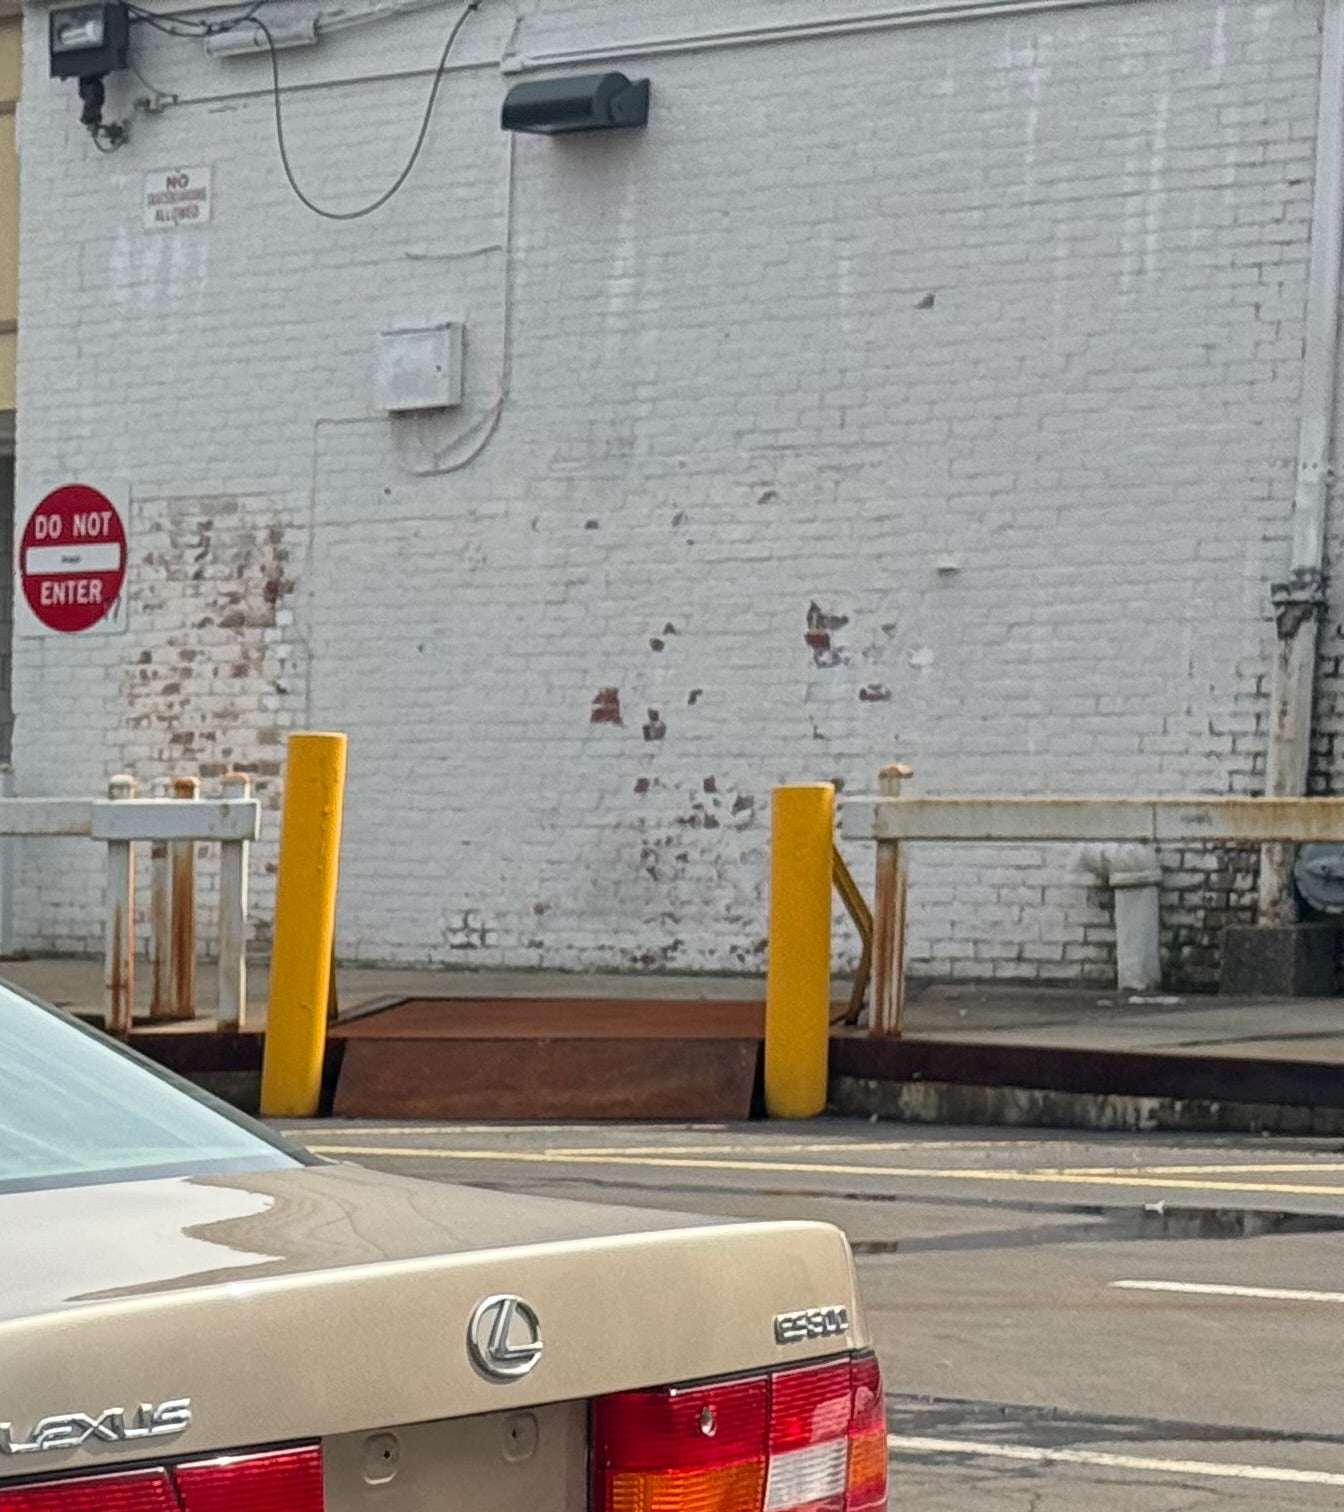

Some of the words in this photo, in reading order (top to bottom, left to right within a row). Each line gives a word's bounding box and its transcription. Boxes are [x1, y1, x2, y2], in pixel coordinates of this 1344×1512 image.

[165, 173, 190, 190] NO
[34, 513, 63, 540] DO
[72, 510, 113, 538] NOT
[40, 578, 103, 606] ENTER
